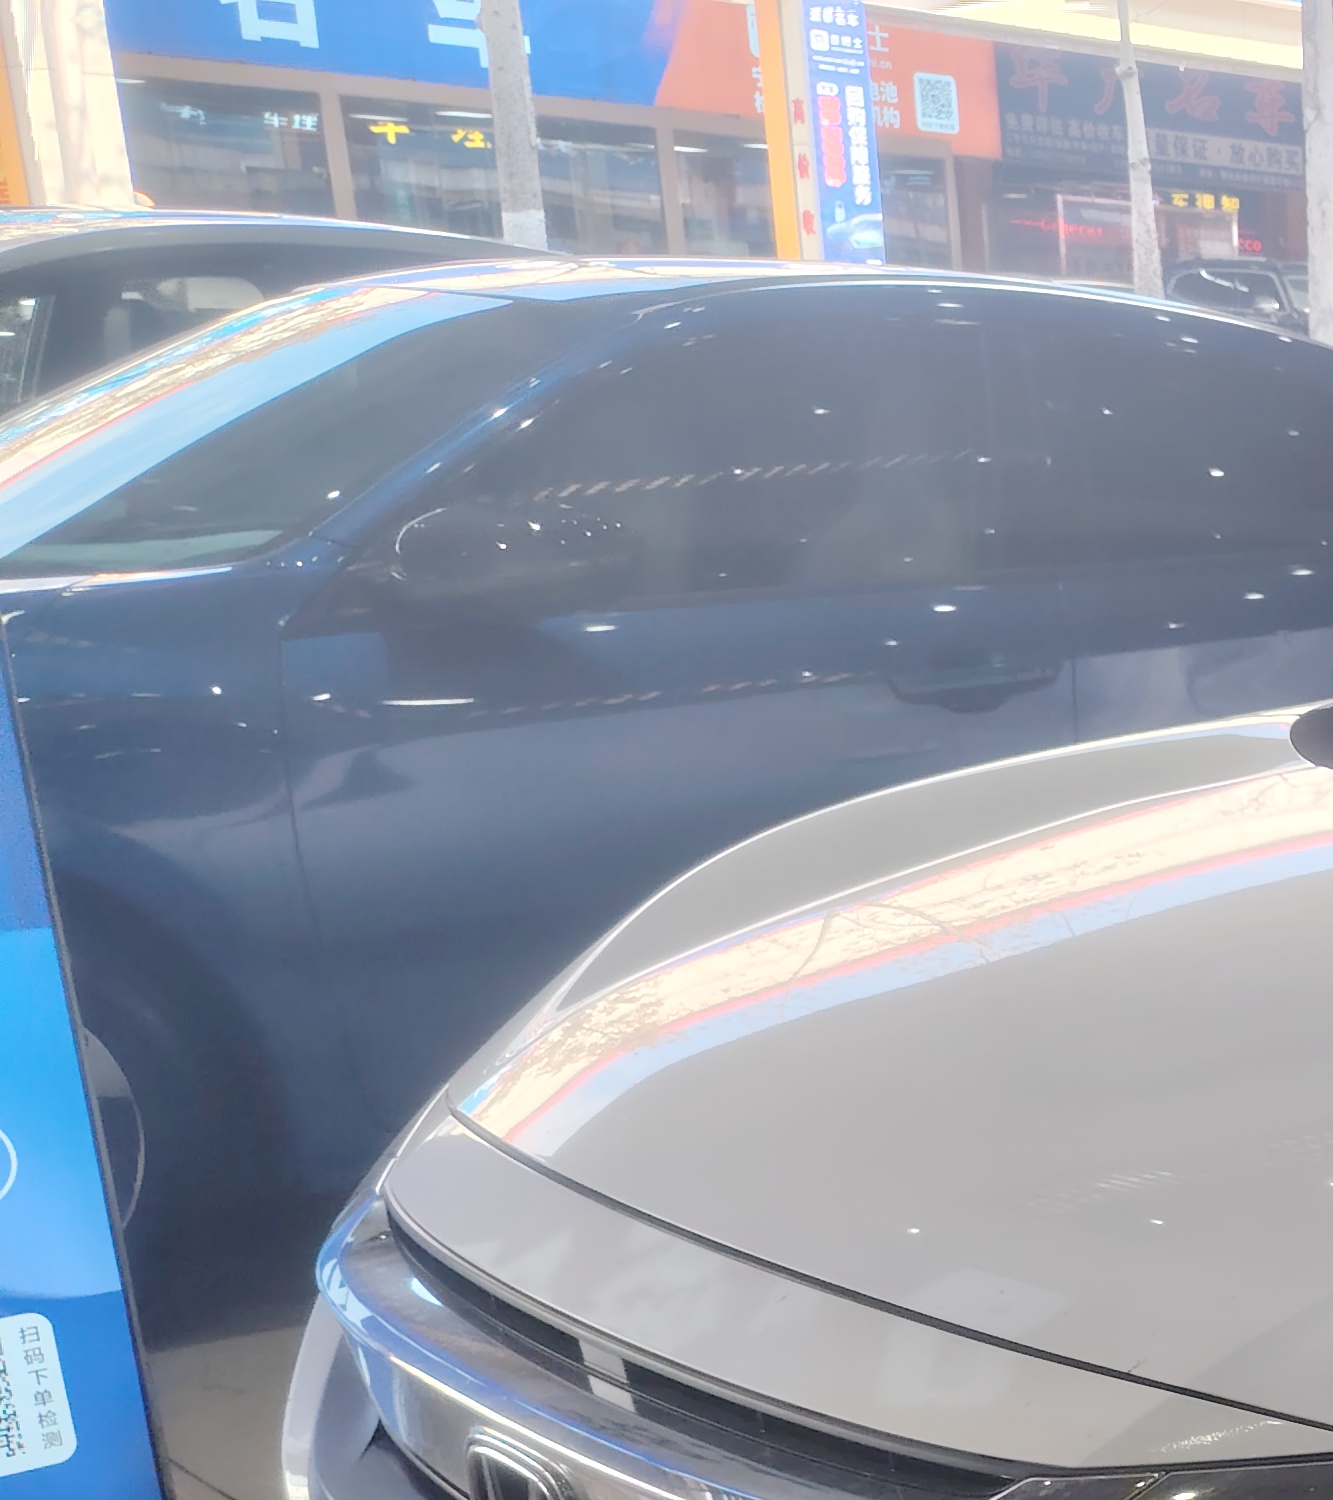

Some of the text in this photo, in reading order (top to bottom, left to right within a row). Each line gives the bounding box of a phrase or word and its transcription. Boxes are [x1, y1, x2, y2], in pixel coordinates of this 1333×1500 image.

[18, 1325, 64, 1451] 扫码下单检测
